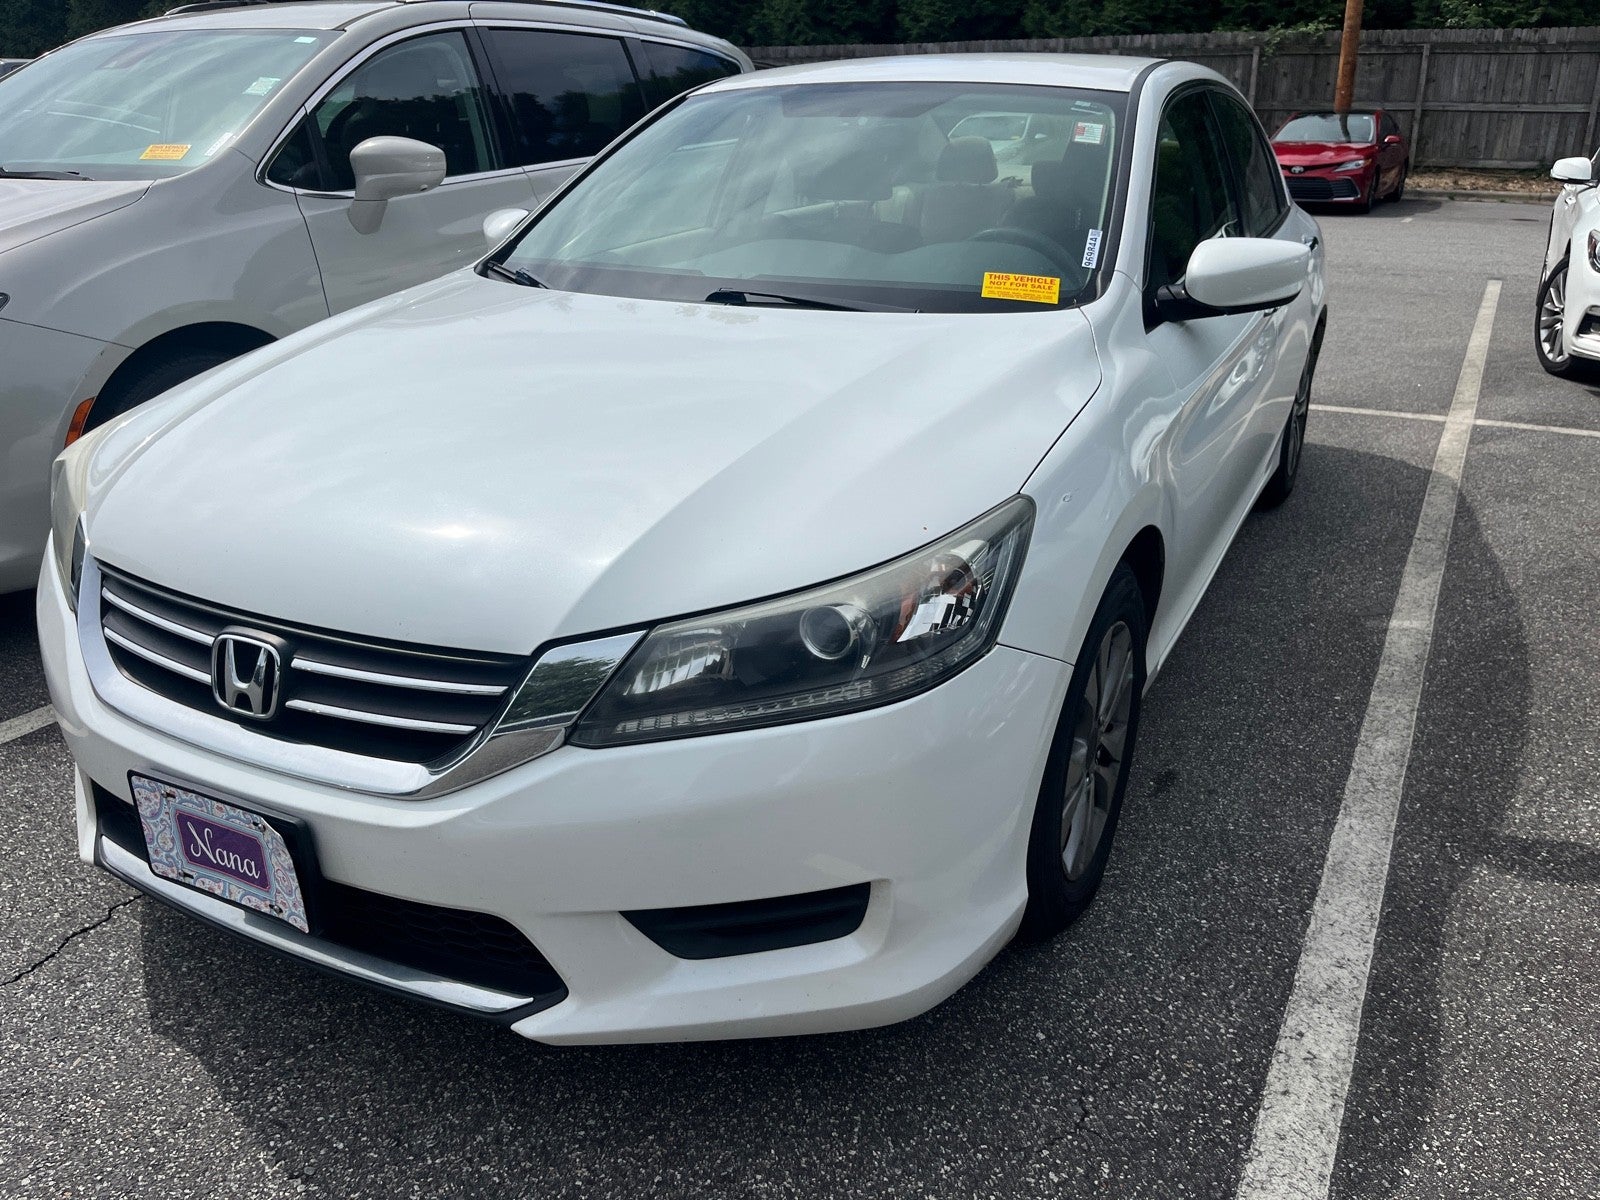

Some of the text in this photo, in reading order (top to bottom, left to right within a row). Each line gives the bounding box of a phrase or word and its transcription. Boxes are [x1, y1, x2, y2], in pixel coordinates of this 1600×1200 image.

[988, 273, 1056, 285] THIS VEHICLE
[1030, 283, 1054, 291] SALE
[187, 821, 261, 879] Nana
